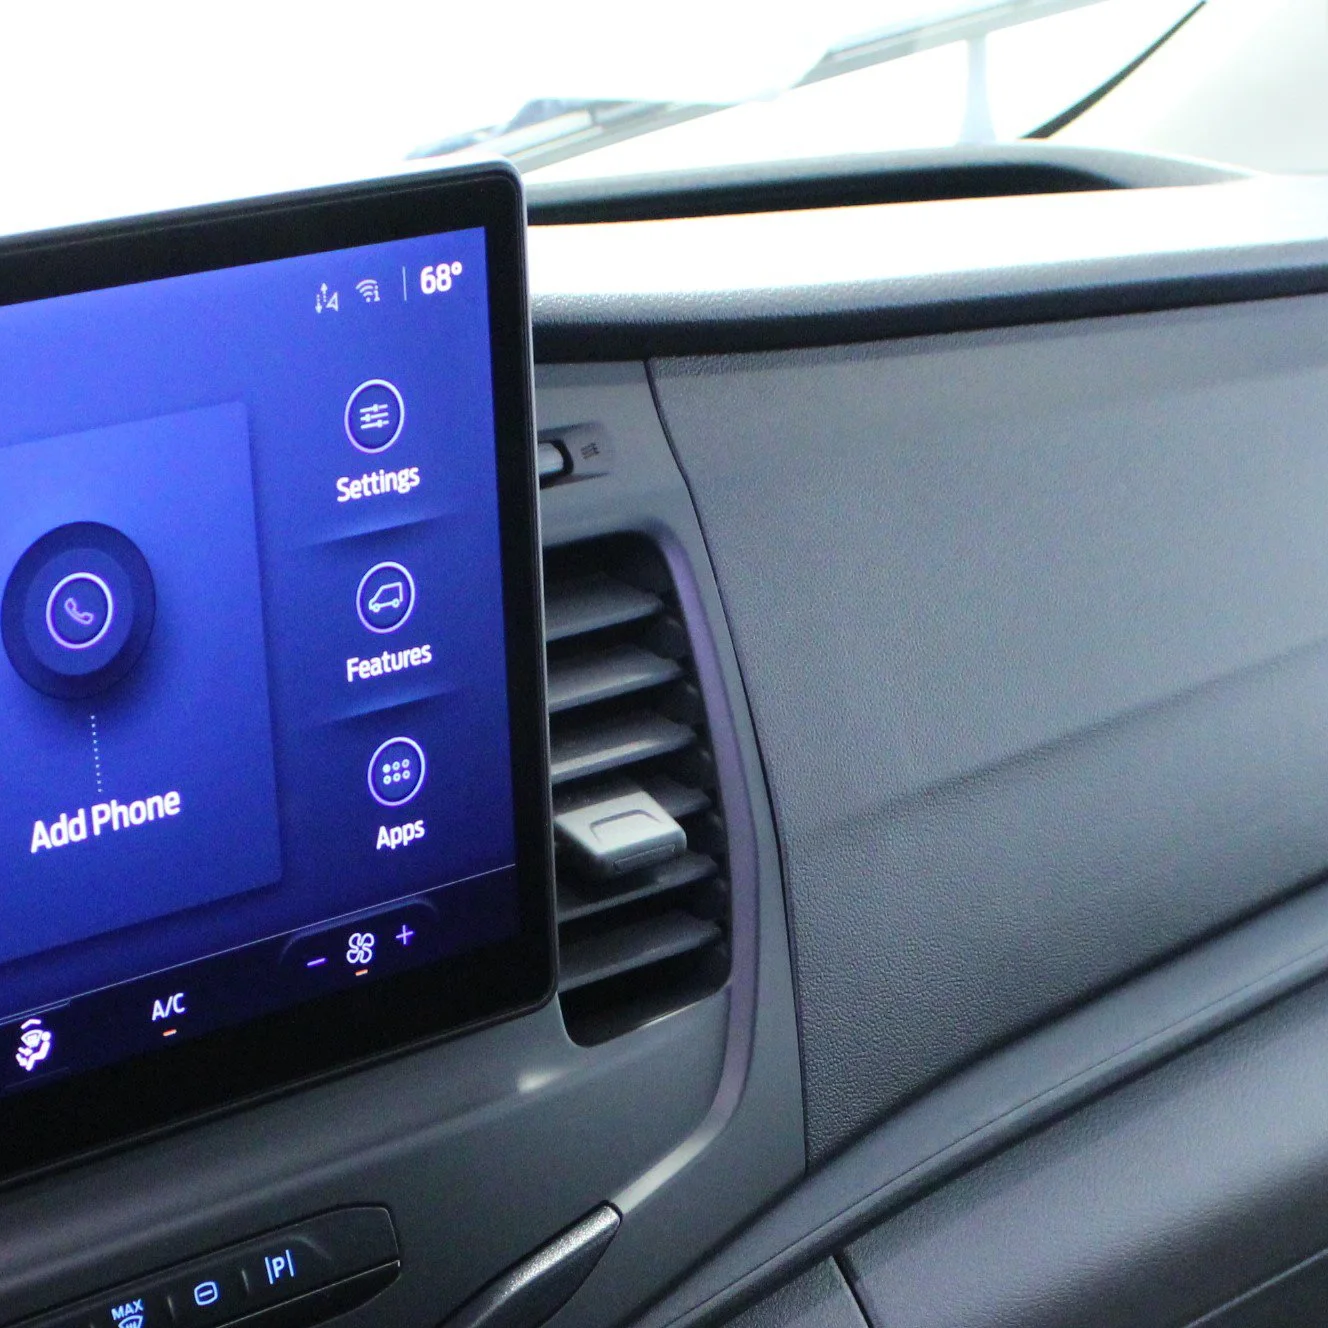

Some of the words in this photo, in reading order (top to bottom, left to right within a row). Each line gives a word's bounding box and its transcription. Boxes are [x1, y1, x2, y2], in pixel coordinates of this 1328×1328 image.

[420, 261, 463, 295] 68°
[336, 465, 420, 502] Settings
[346, 643, 432, 682] Features
[30, 807, 86, 853] Add
[91, 790, 181, 838] Phone
[376, 820, 425, 850] Apps
[151, 993, 185, 1021] A/C
[111, 1299, 144, 1320] MAX
